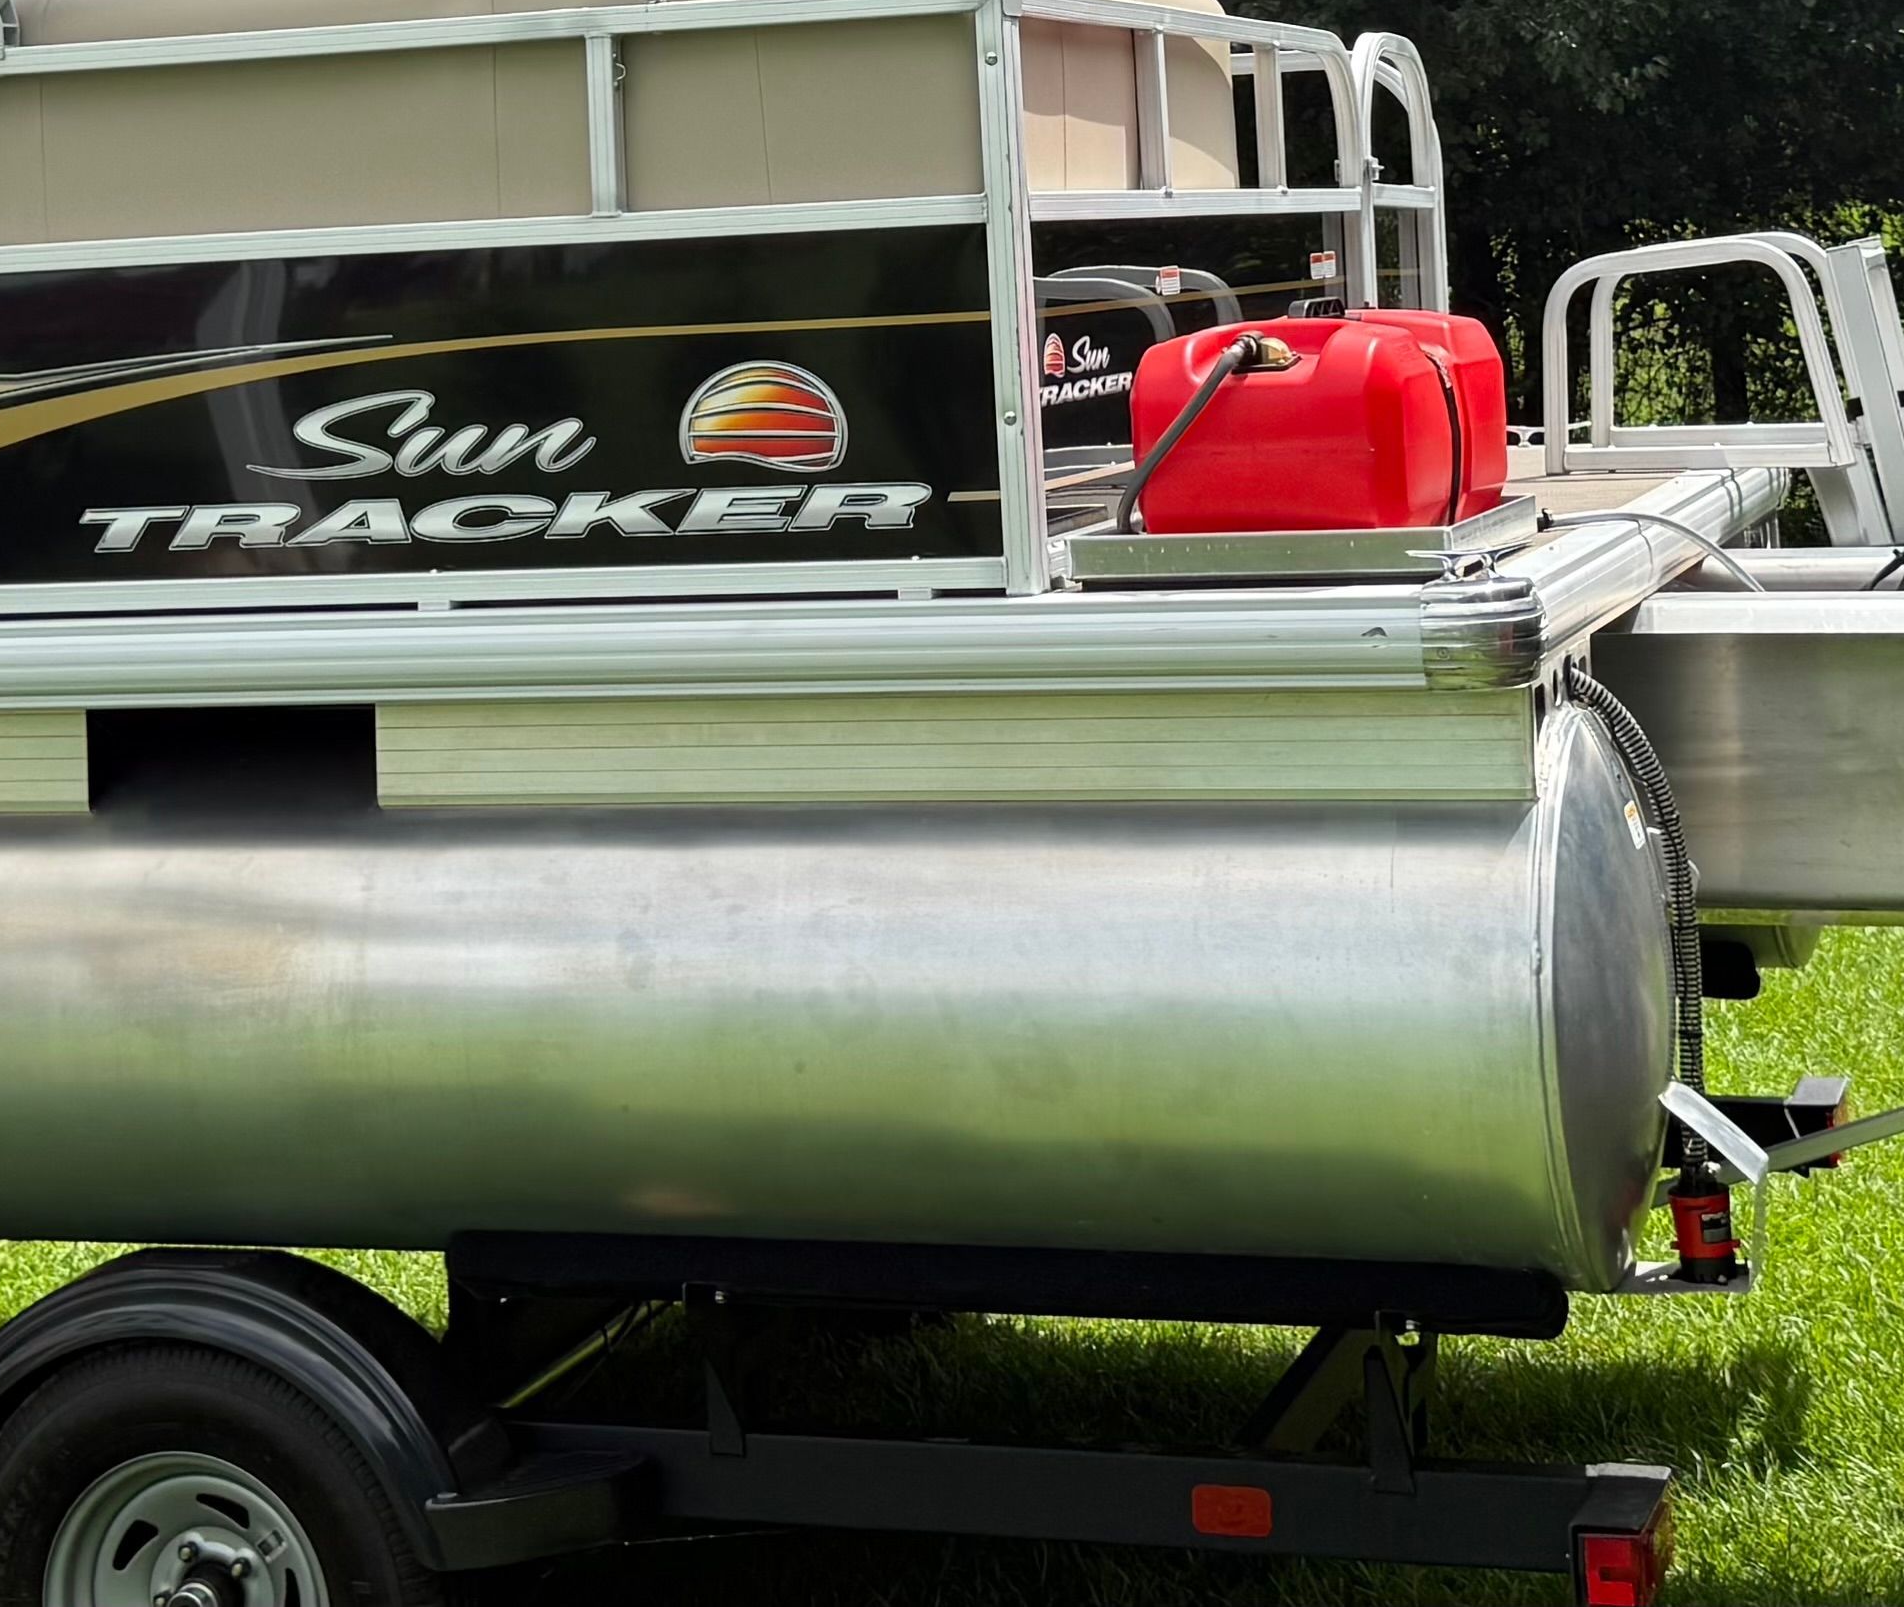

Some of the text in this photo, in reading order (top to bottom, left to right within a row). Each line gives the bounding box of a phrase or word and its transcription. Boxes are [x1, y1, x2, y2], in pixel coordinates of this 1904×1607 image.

[1067, 335, 1111, 374] Sun
[245, 388, 596, 481] Sun
[78, 482, 932, 554] TRACKER
